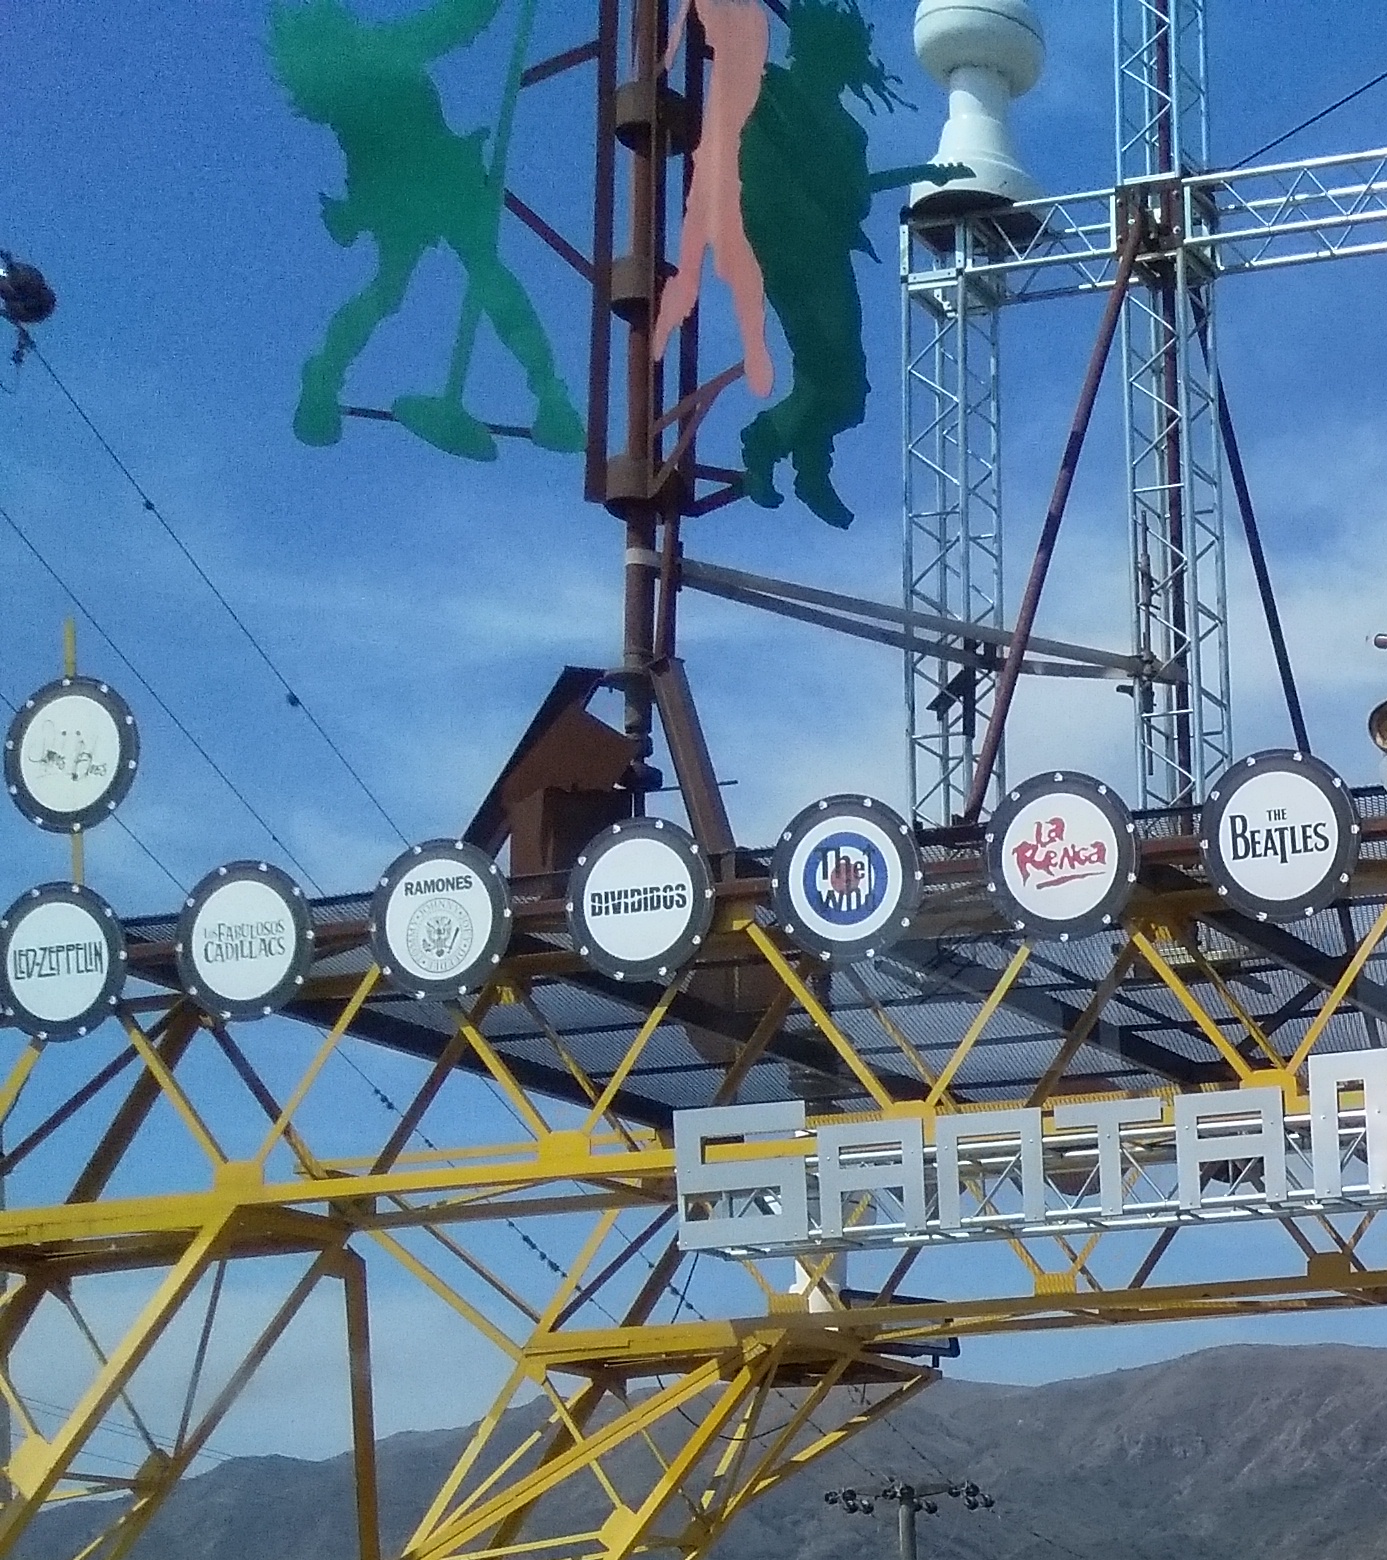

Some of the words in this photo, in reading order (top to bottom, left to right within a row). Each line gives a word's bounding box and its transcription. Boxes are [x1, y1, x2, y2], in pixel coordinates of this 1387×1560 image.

[1266, 809, 1288, 821] THE
[1229, 815, 1330, 864] BEATLES
[404, 875, 472, 896] RAMONES
[591, 884, 687, 917] DIVIDIDOS
[204, 937, 285, 963] CADILLACS
